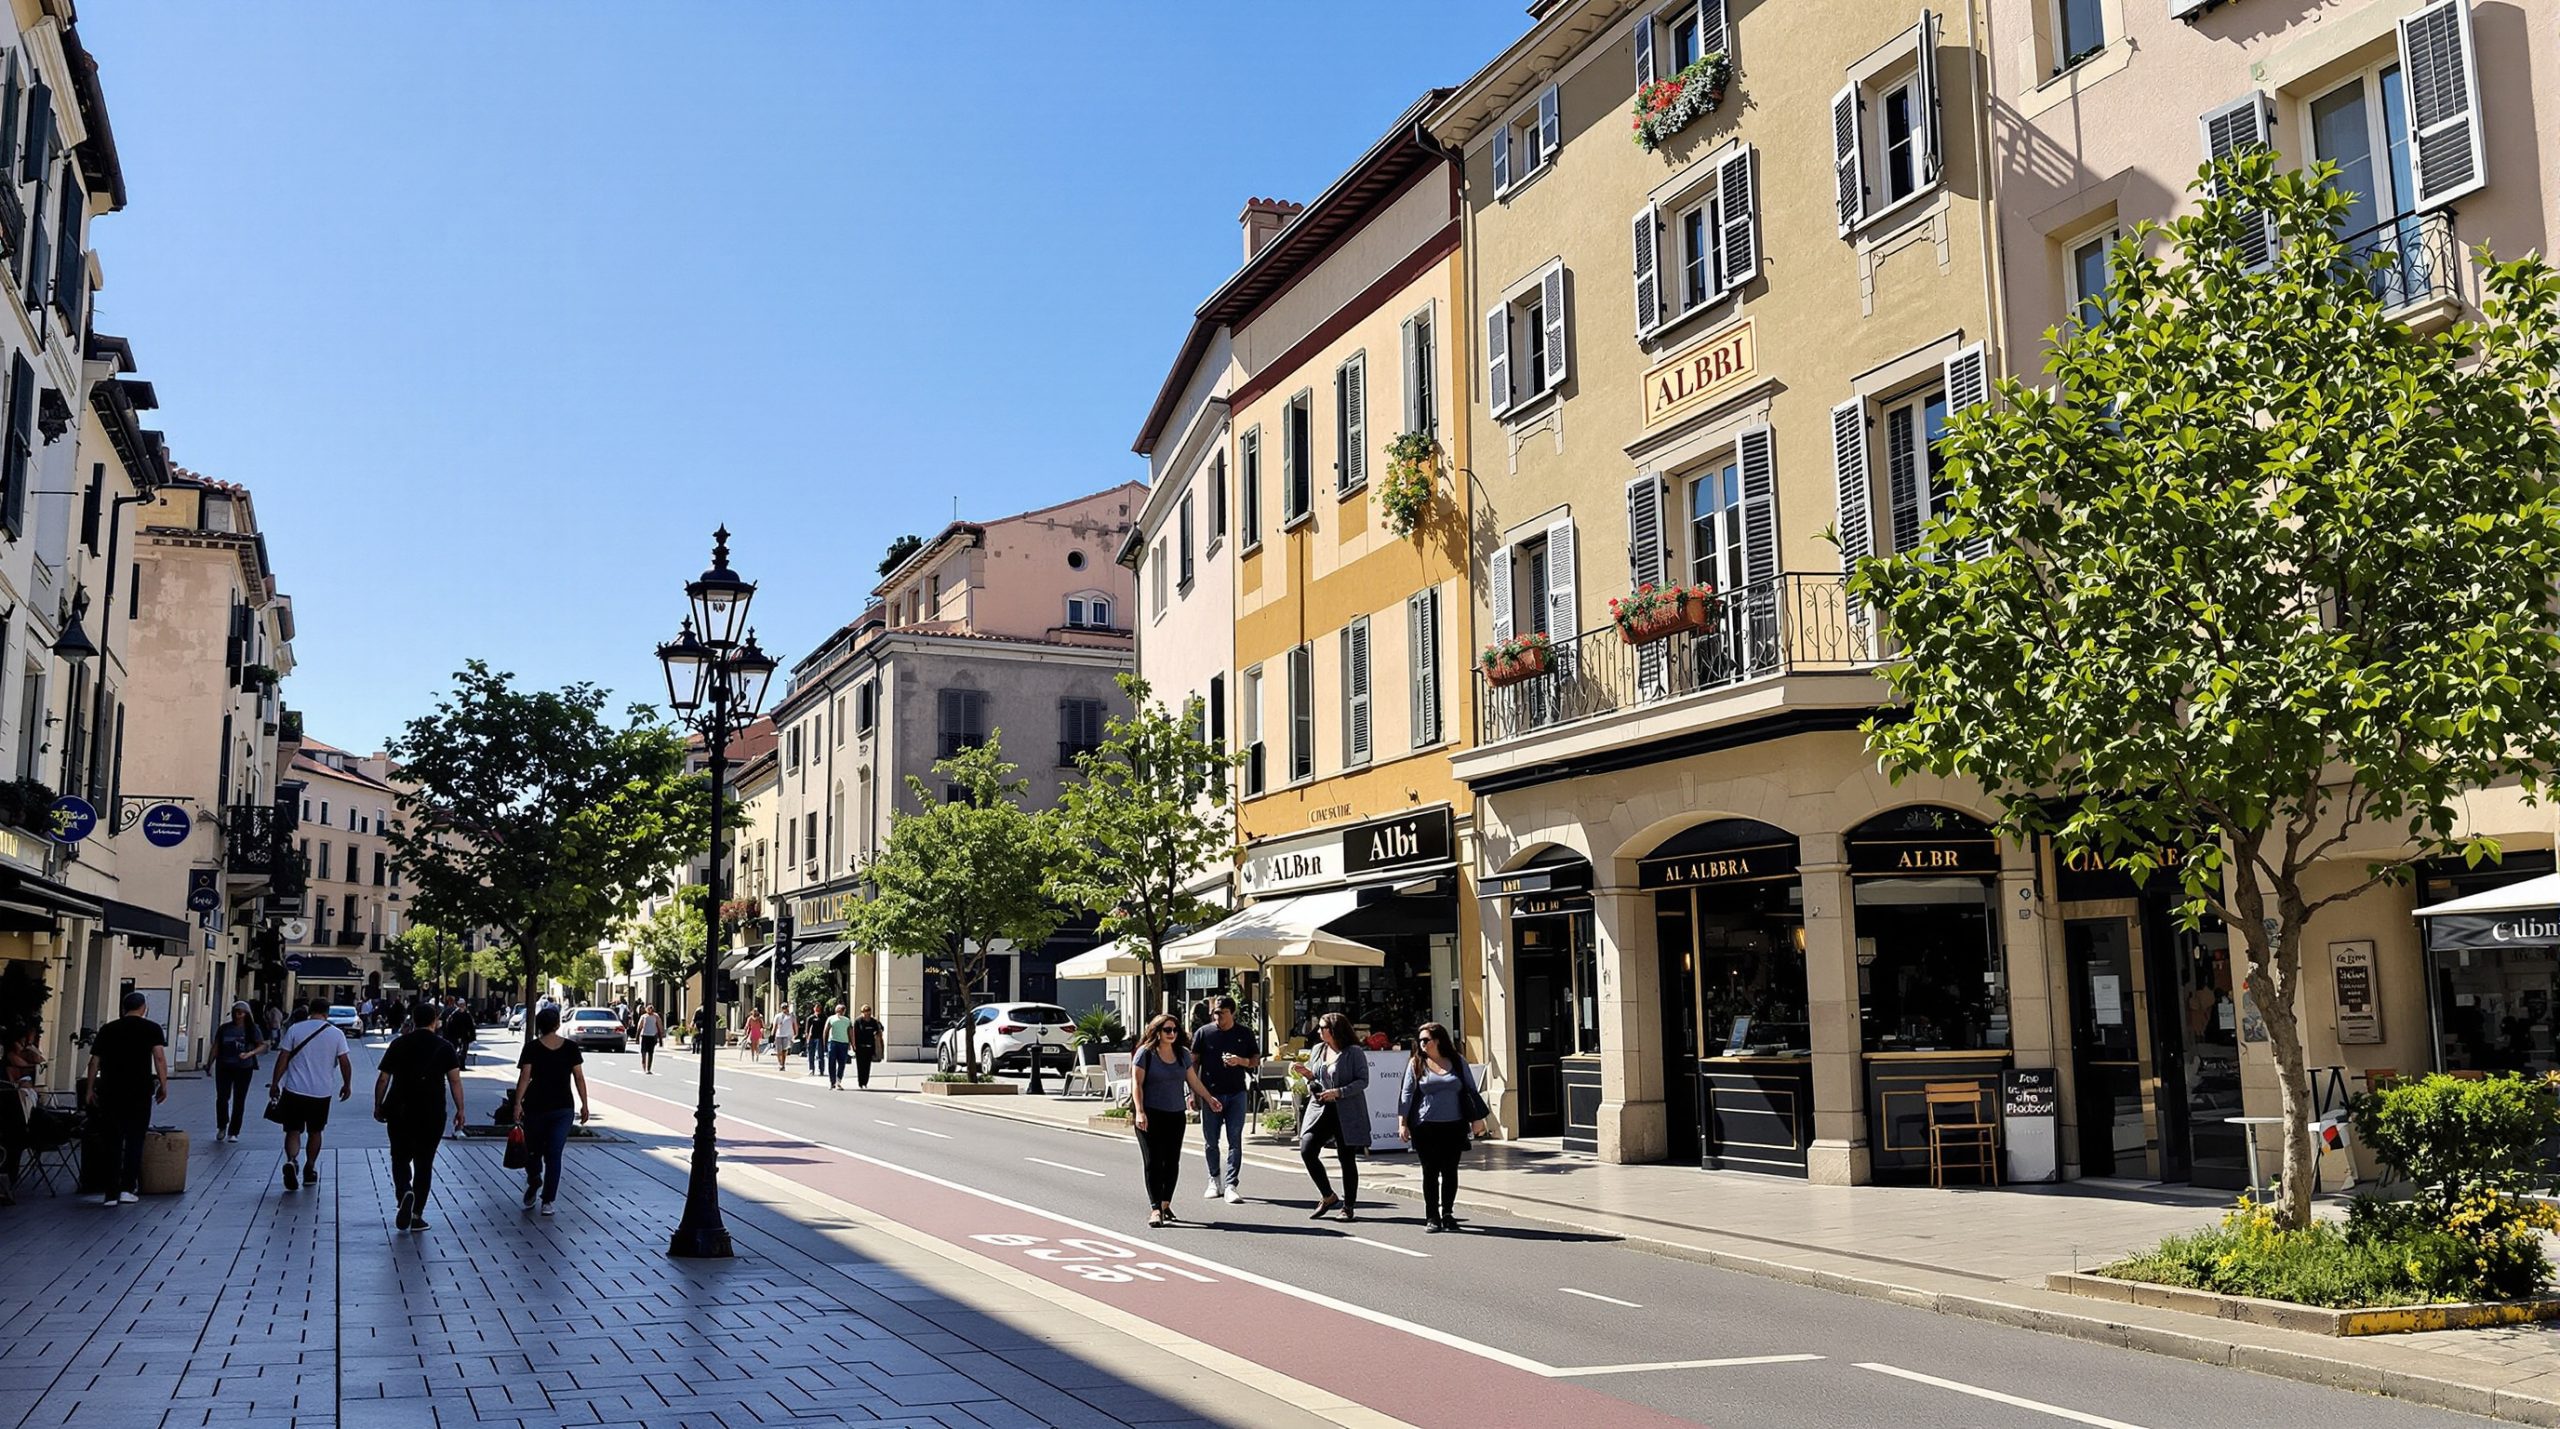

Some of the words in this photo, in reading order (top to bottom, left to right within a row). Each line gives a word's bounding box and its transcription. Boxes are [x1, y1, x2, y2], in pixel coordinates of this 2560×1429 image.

[1369, 821, 1419, 862] Albi
[1666, 865, 1684, 882] AL
[1690, 857, 1750, 880] ALBBRA
[1897, 850, 1959, 868] ALBR
